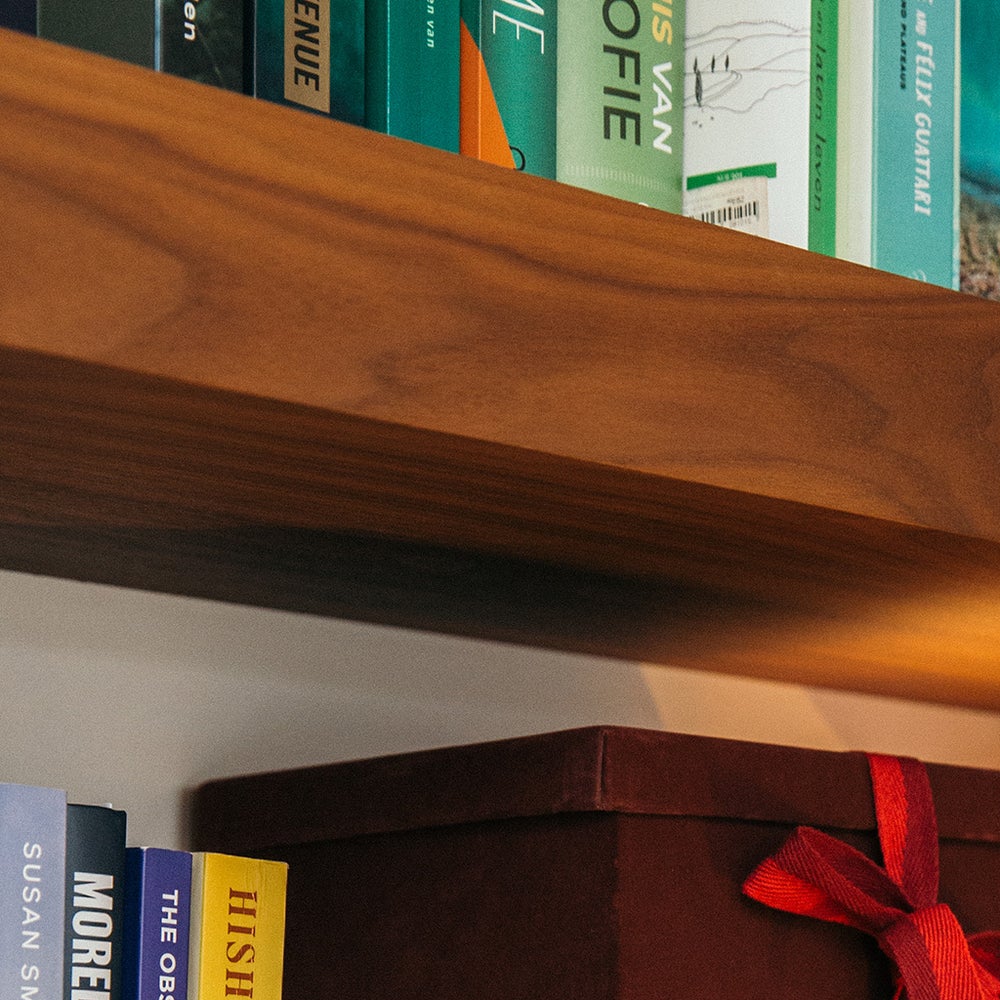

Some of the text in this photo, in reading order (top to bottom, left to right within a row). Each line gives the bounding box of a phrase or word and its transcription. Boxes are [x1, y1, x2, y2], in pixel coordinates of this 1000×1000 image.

[183, 0, 197, 41] en
[294, 0, 320, 91] ENUE
[427, 20, 435, 48] van
[652, 0, 673, 154] IS VAN
[815, 44, 826, 121] laten
[814, 133, 826, 212] leven
[914, 112, 932, 216] GUATTARI
[21, 841, 42, 950] SUSAN
[159, 889, 179, 944] THE
